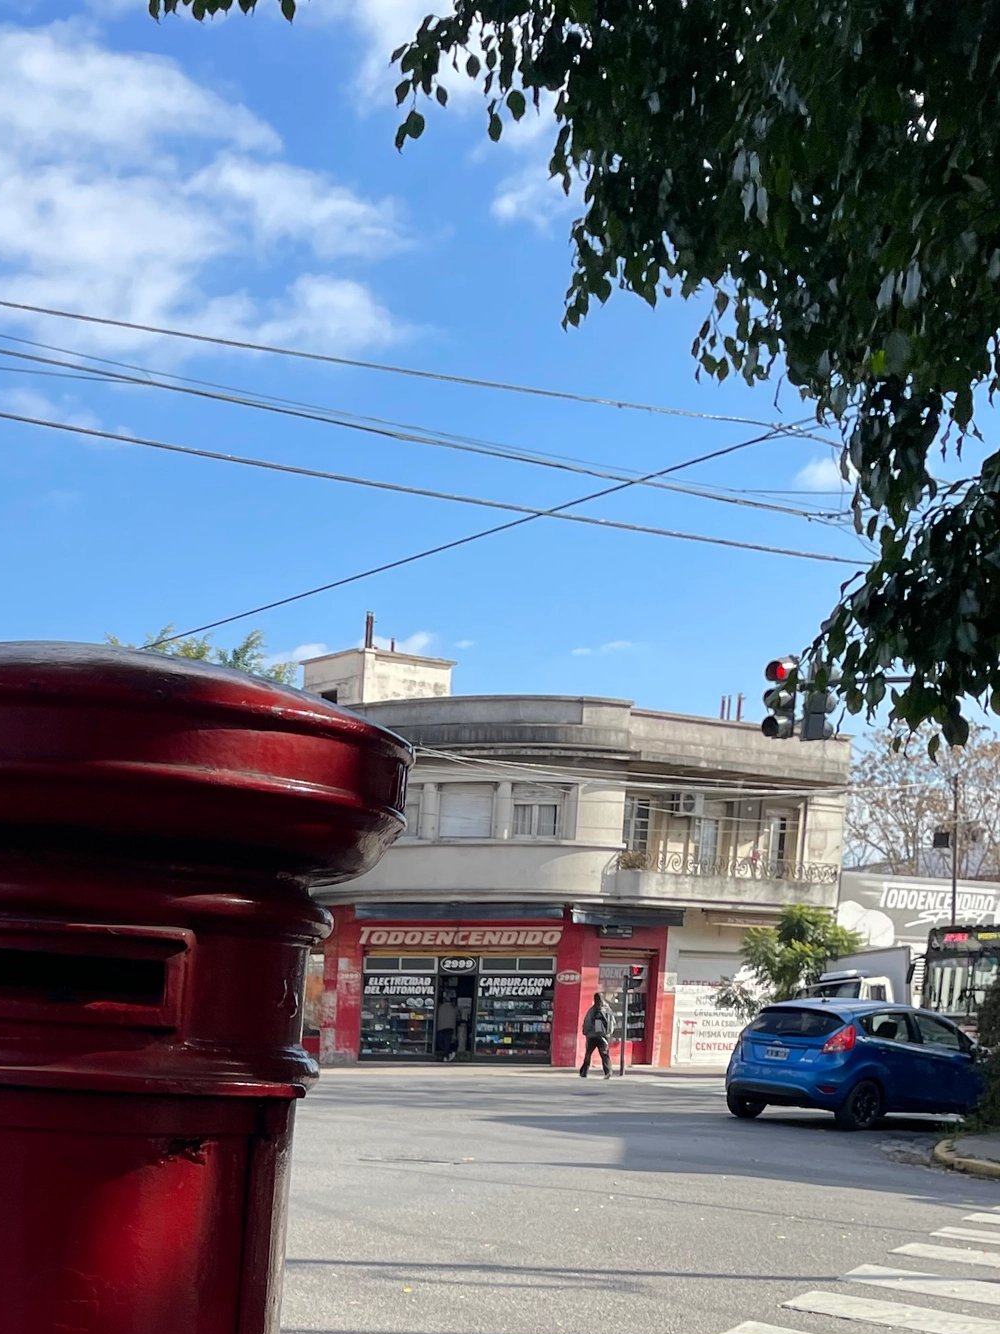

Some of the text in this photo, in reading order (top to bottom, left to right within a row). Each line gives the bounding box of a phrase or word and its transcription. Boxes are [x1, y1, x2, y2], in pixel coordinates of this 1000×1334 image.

[359, 926, 563, 946] TODOENCENDIDO
[443, 959, 474, 969] 2999
[368, 976, 432, 987] ELECTRICIDAD
[479, 976, 553, 987] CARBURACION
[364, 985, 435, 995] DEL AUTOMOVIL
[488, 986, 543, 997] INYECCION
[695, 1042, 734, 1051] CENTENE
